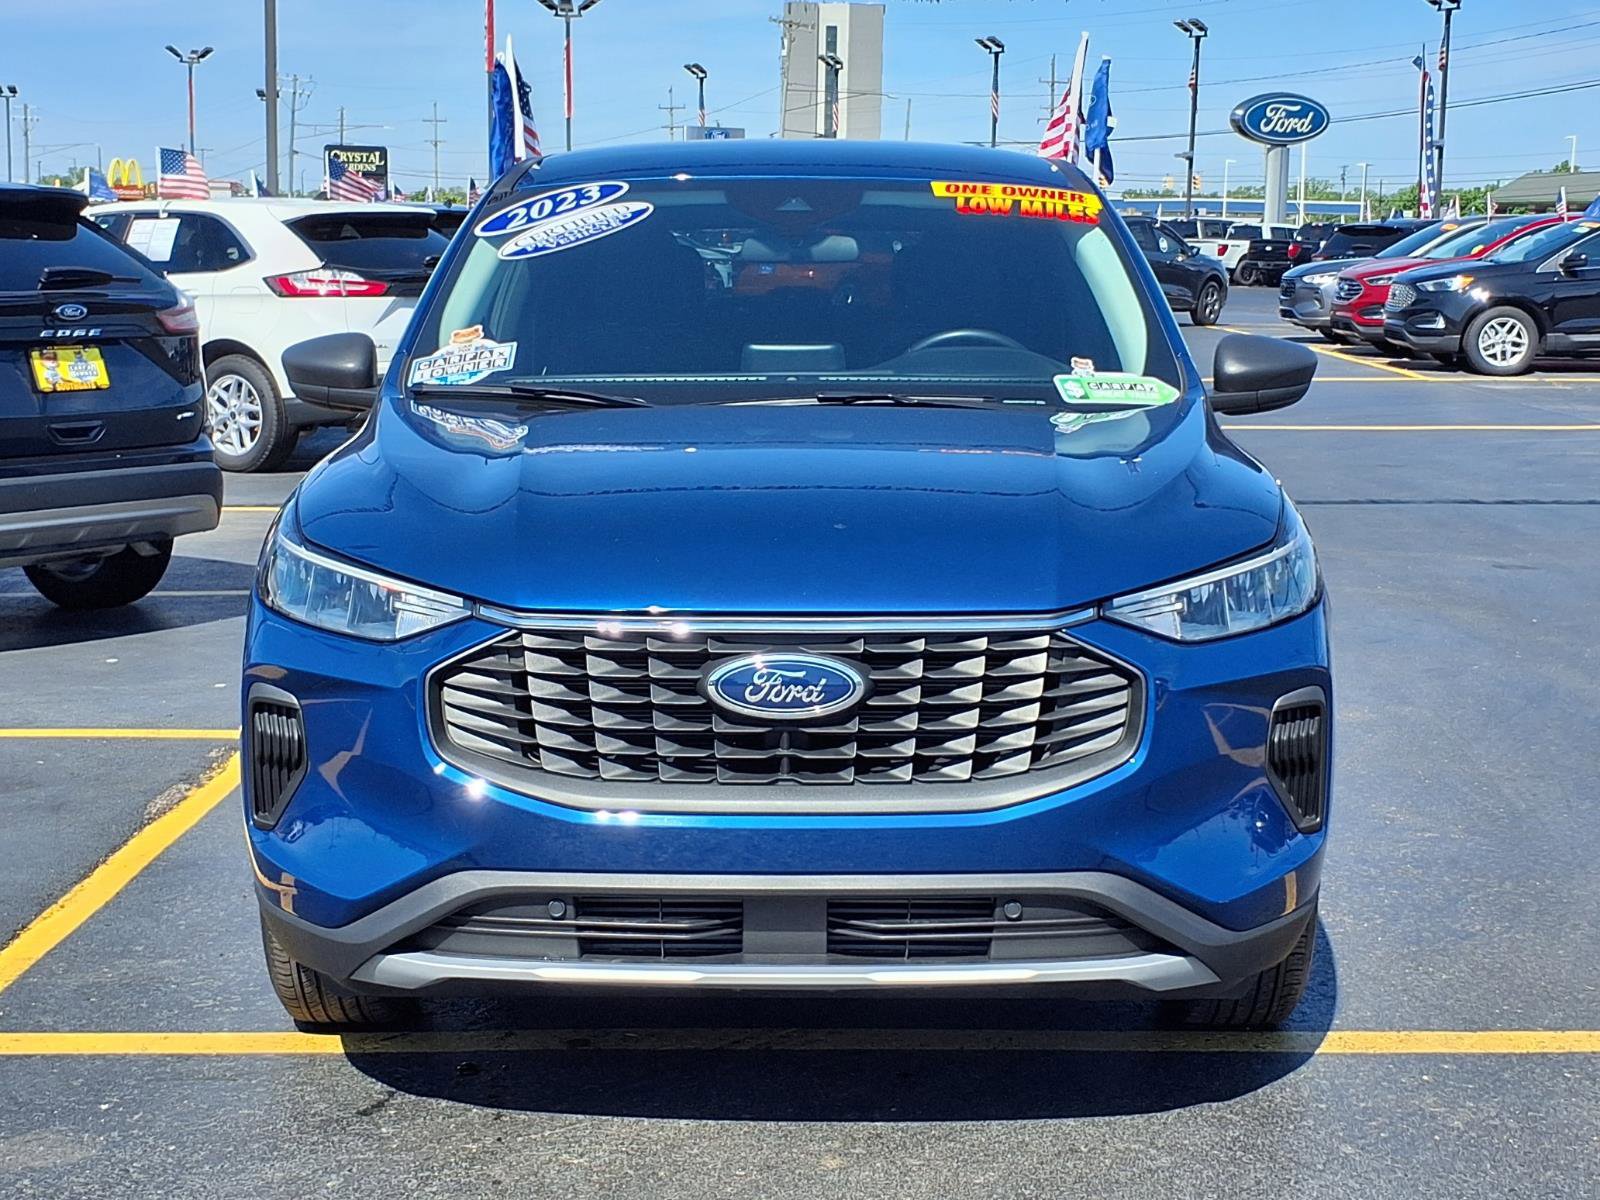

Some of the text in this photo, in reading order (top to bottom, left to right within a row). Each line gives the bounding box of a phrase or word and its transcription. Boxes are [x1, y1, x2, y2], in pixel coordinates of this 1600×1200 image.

[1260, 104, 1314, 133] Ford
[330, 150, 385, 166] CRYSTAL
[945, 184, 1085, 203] ONE OWNER
[506, 185, 602, 230] 2023
[956, 196, 1101, 224] LOW MILES
[40, 328, 103, 338] EDGE
[418, 350, 508, 371] CARFAX
[744, 667, 827, 703] Ford
